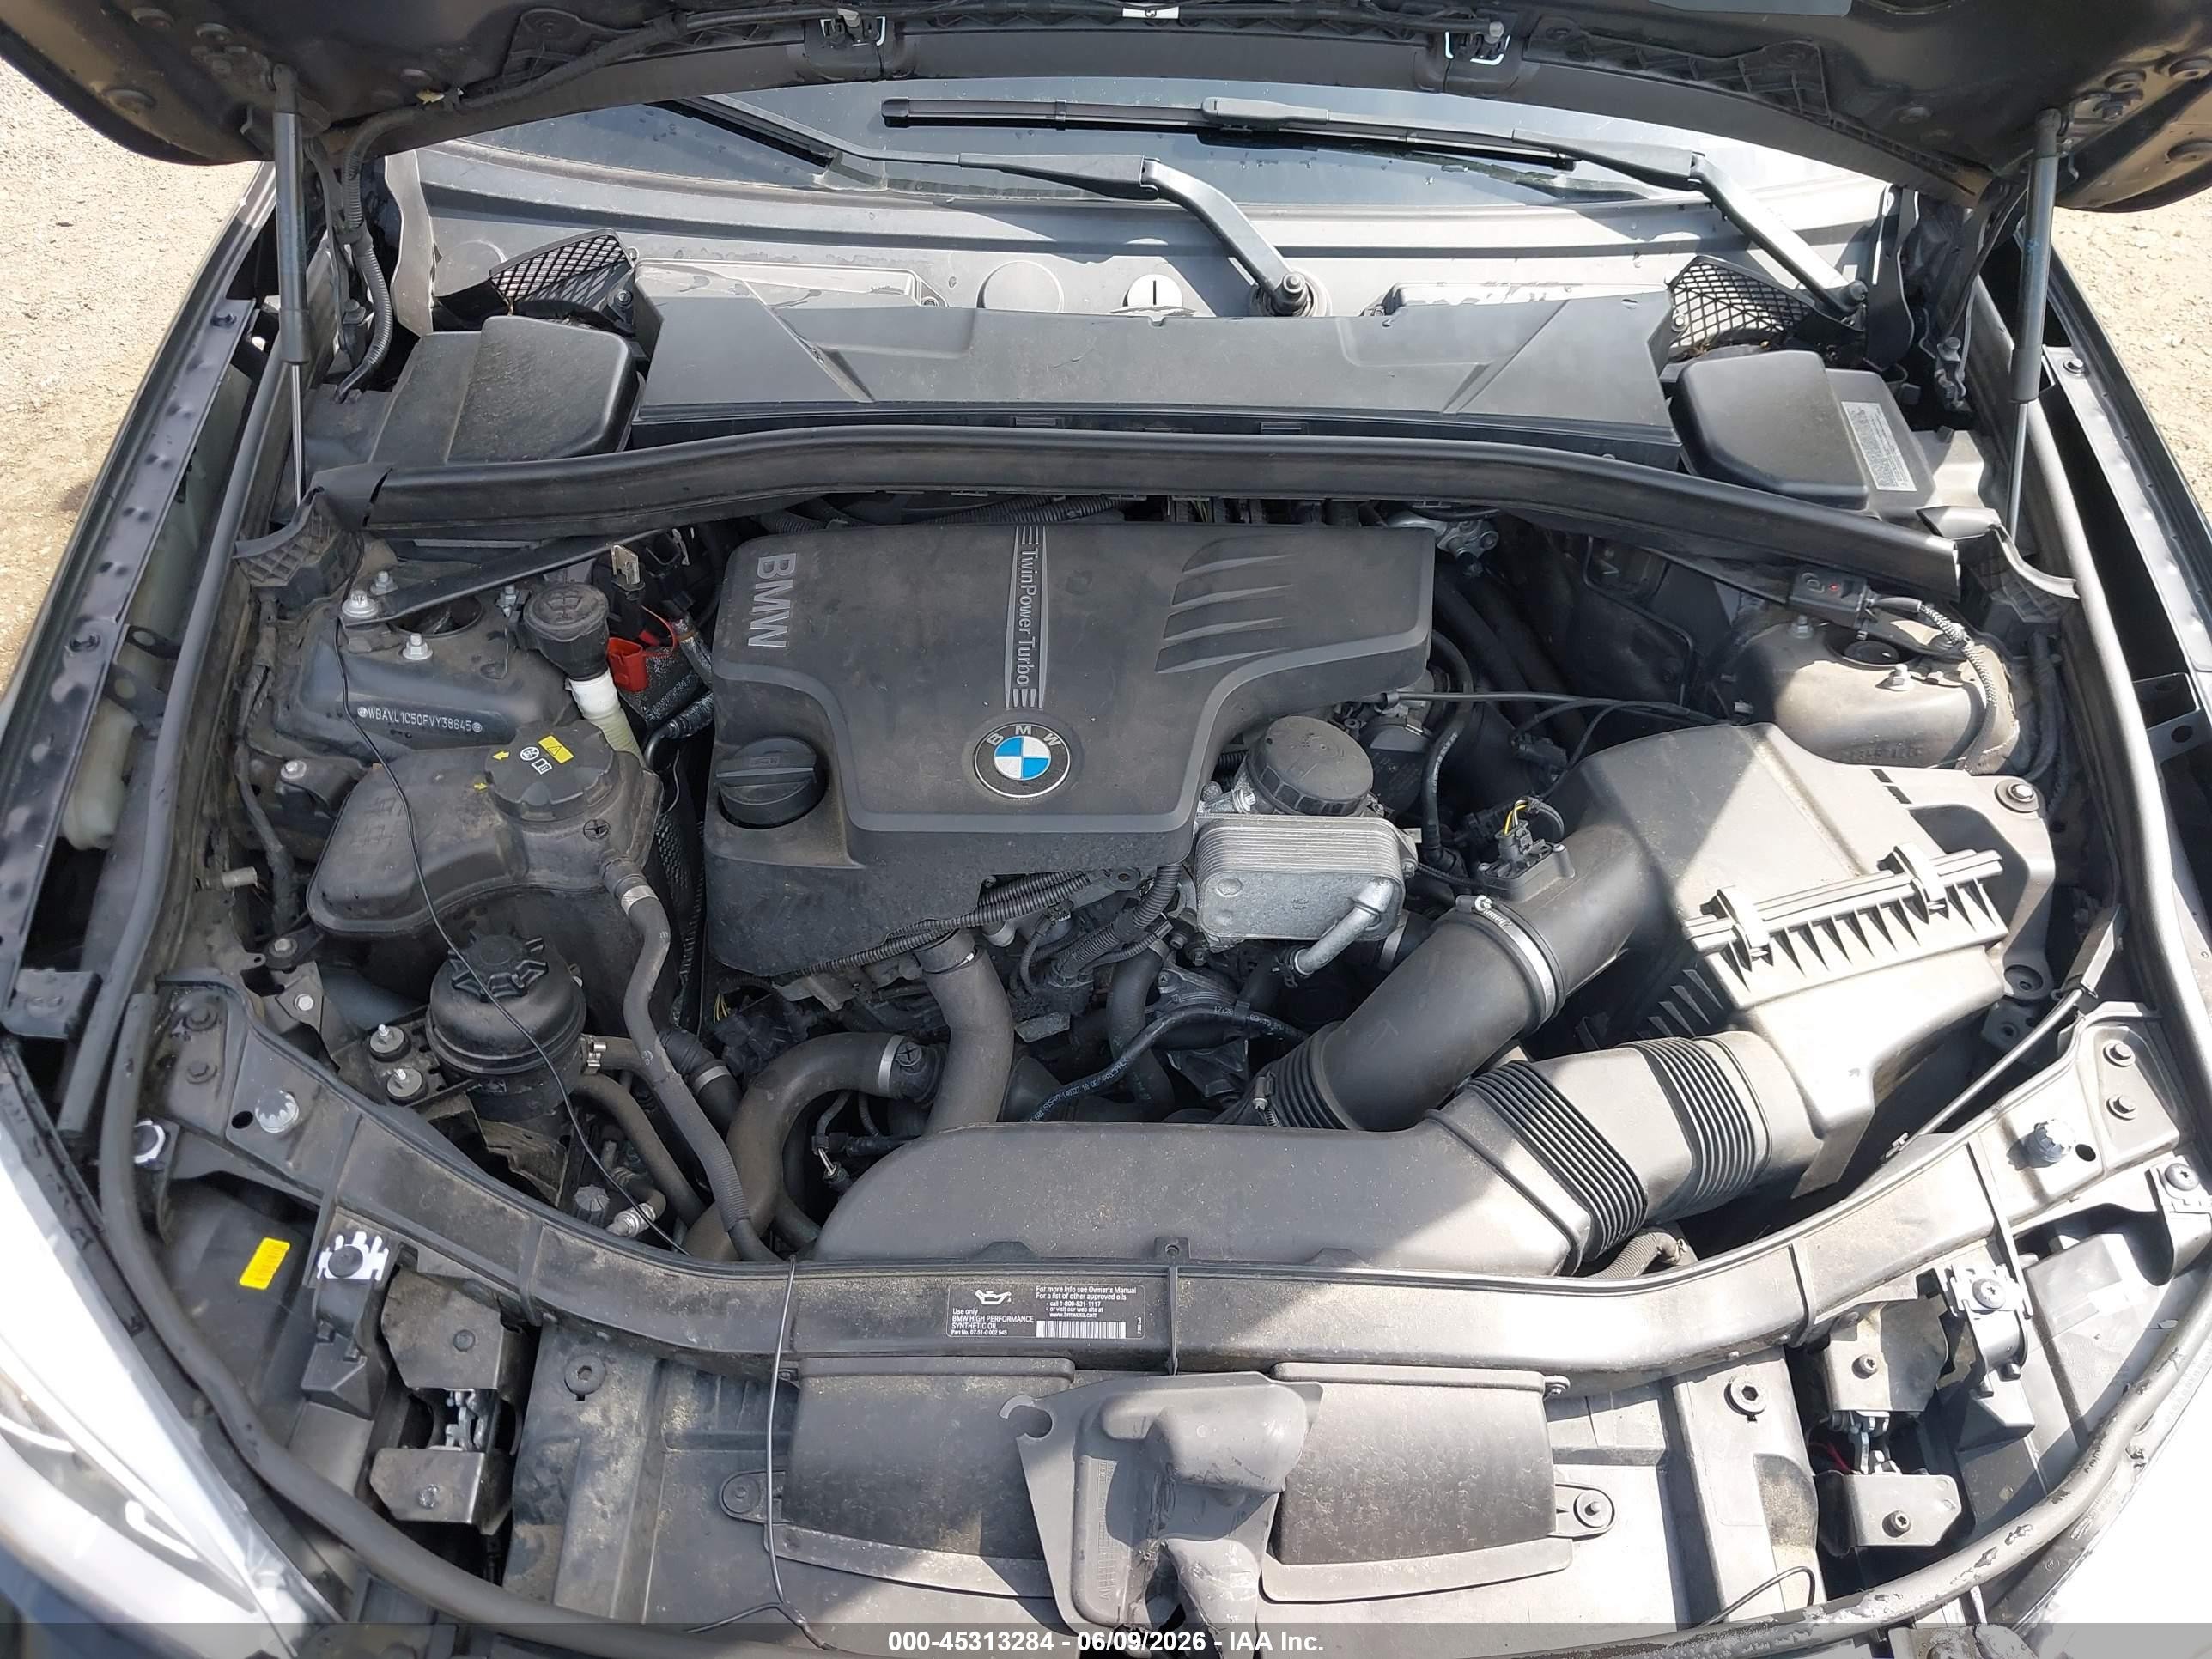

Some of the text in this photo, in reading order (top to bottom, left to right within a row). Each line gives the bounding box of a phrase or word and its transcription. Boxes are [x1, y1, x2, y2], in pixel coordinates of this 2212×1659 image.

[748, 553, 797, 648] BMW
[1017, 547, 1039, 686] TwinPower Turbo
[987, 725, 1061, 747] BMW
[965, 1308, 978, 1317] only
